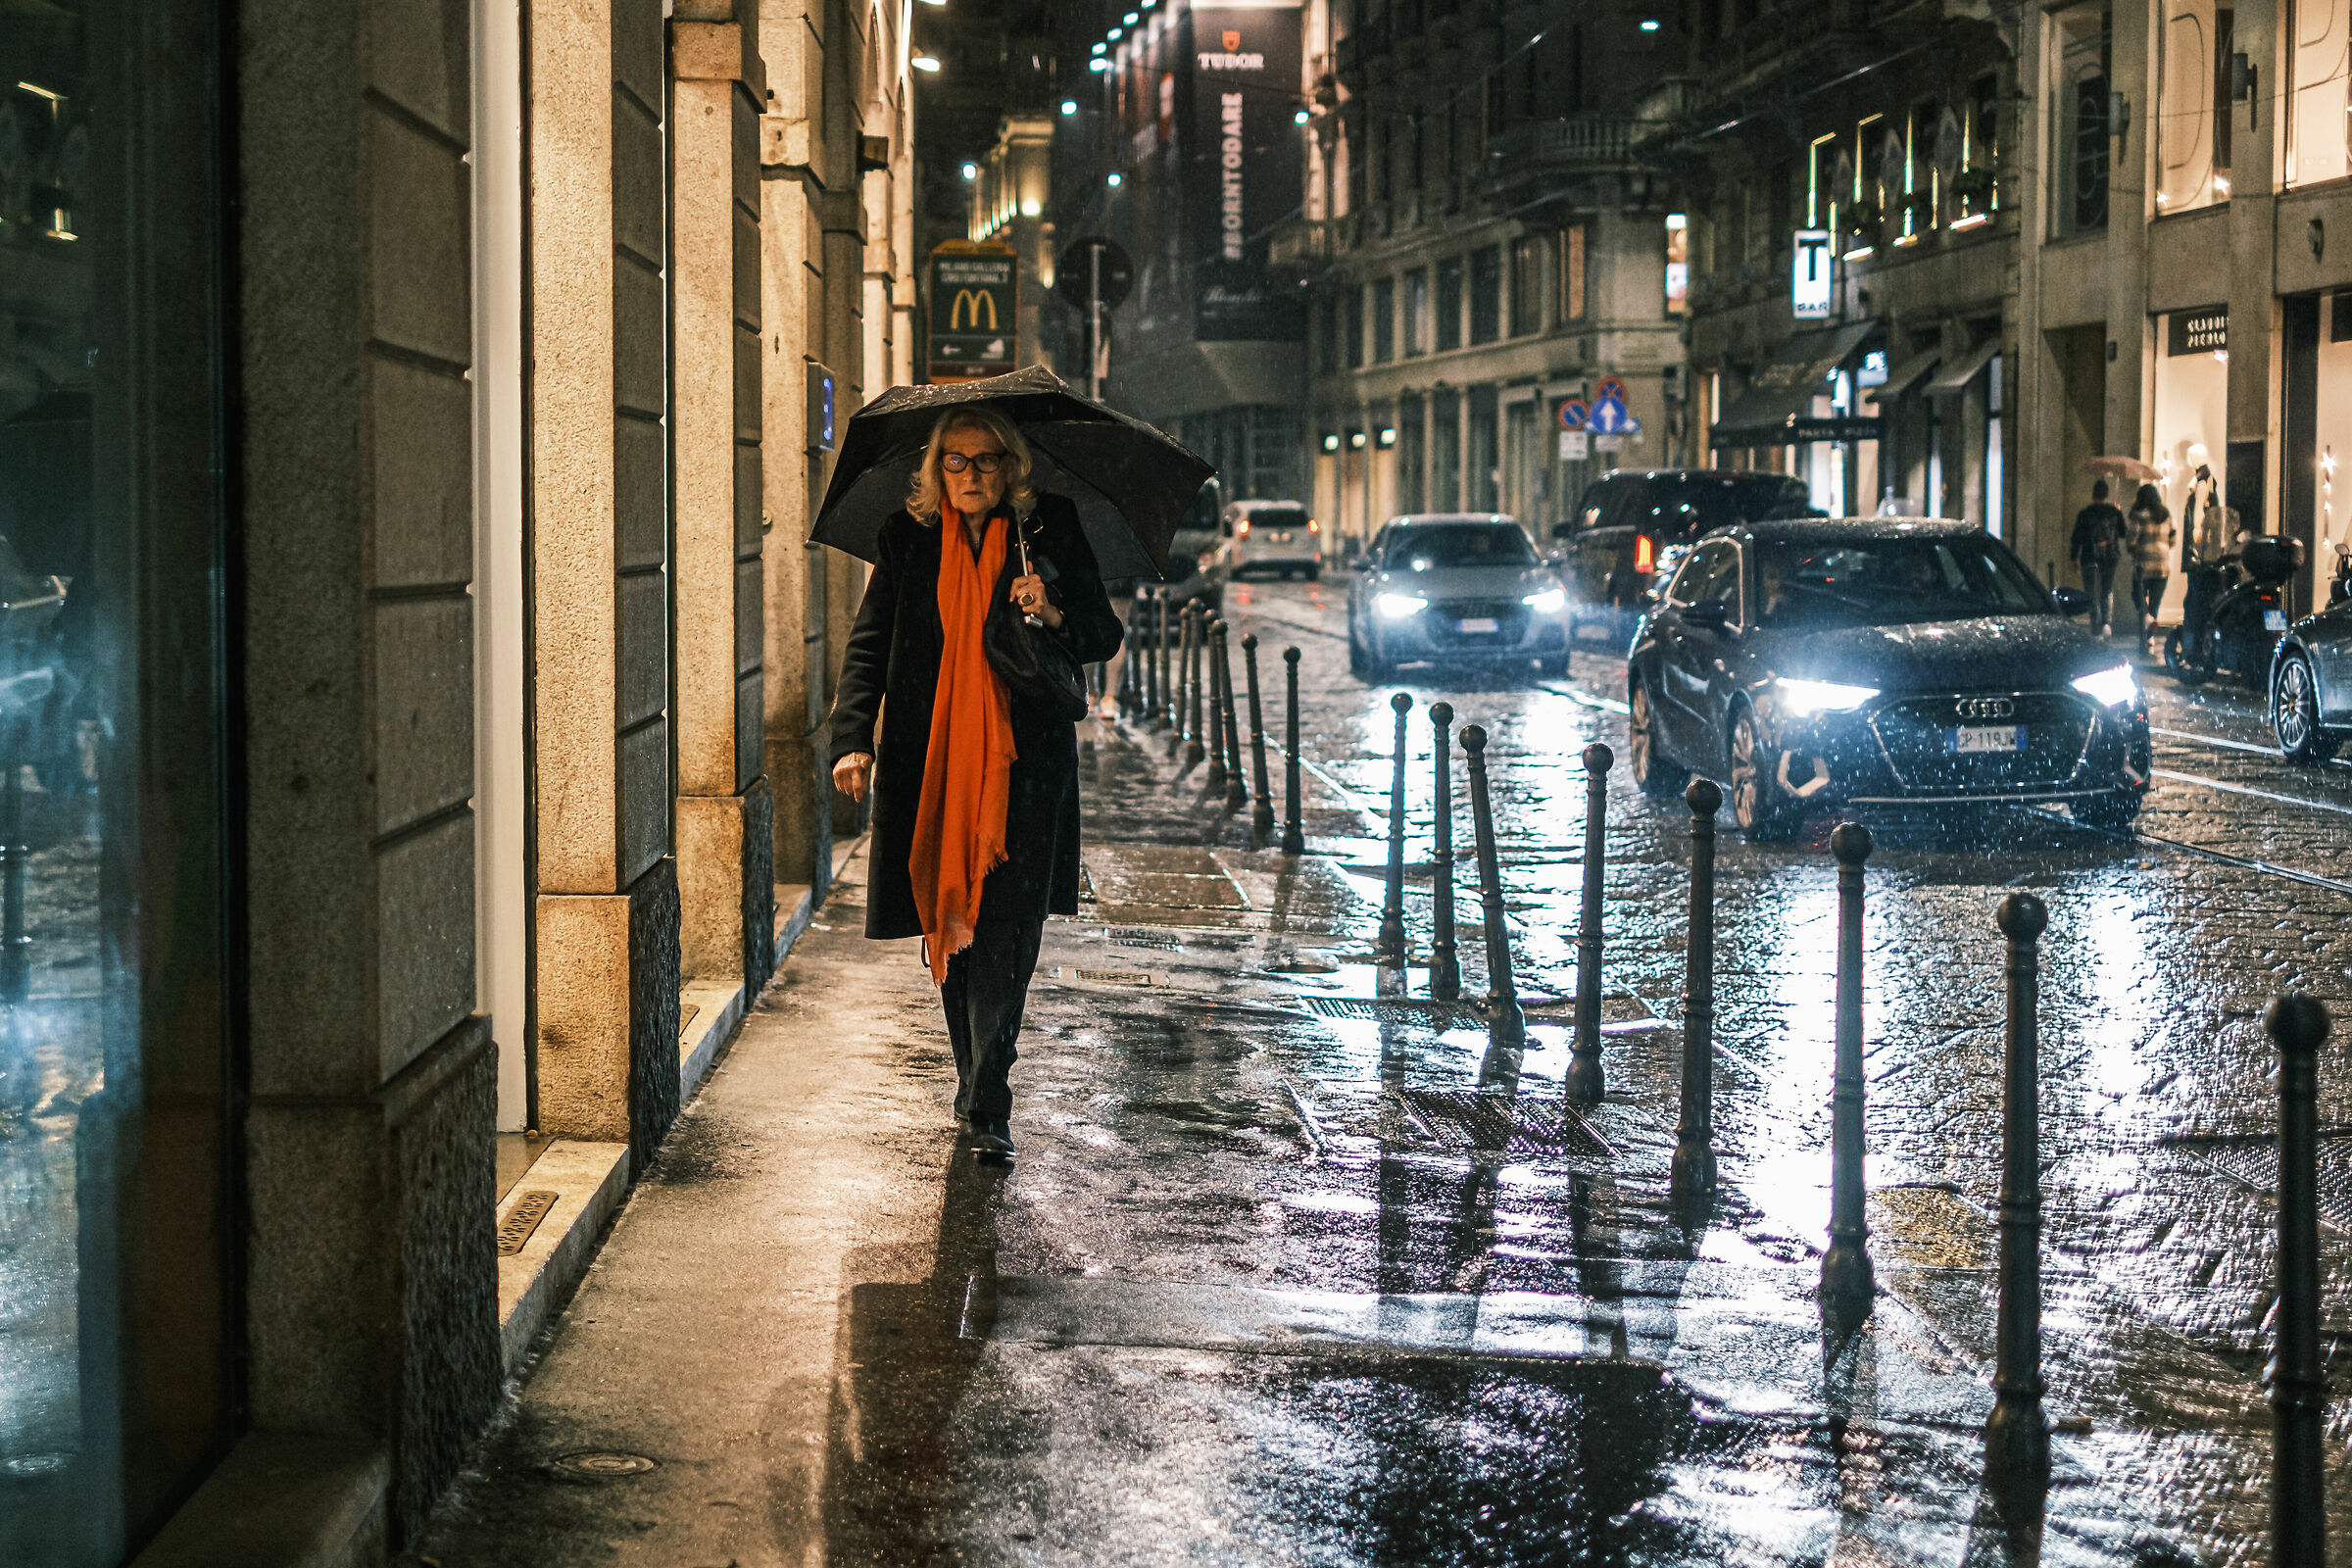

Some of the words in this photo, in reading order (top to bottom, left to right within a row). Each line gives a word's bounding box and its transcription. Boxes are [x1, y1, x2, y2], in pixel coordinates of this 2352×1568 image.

[1198, 52, 1264, 70] TUDOR
[1221, 93, 1243, 259] #BORNTODARE
[1798, 238, 1827, 281] T
[1797, 302, 1827, 312] BAR
[2187, 316, 2229, 332] CLAUDI
